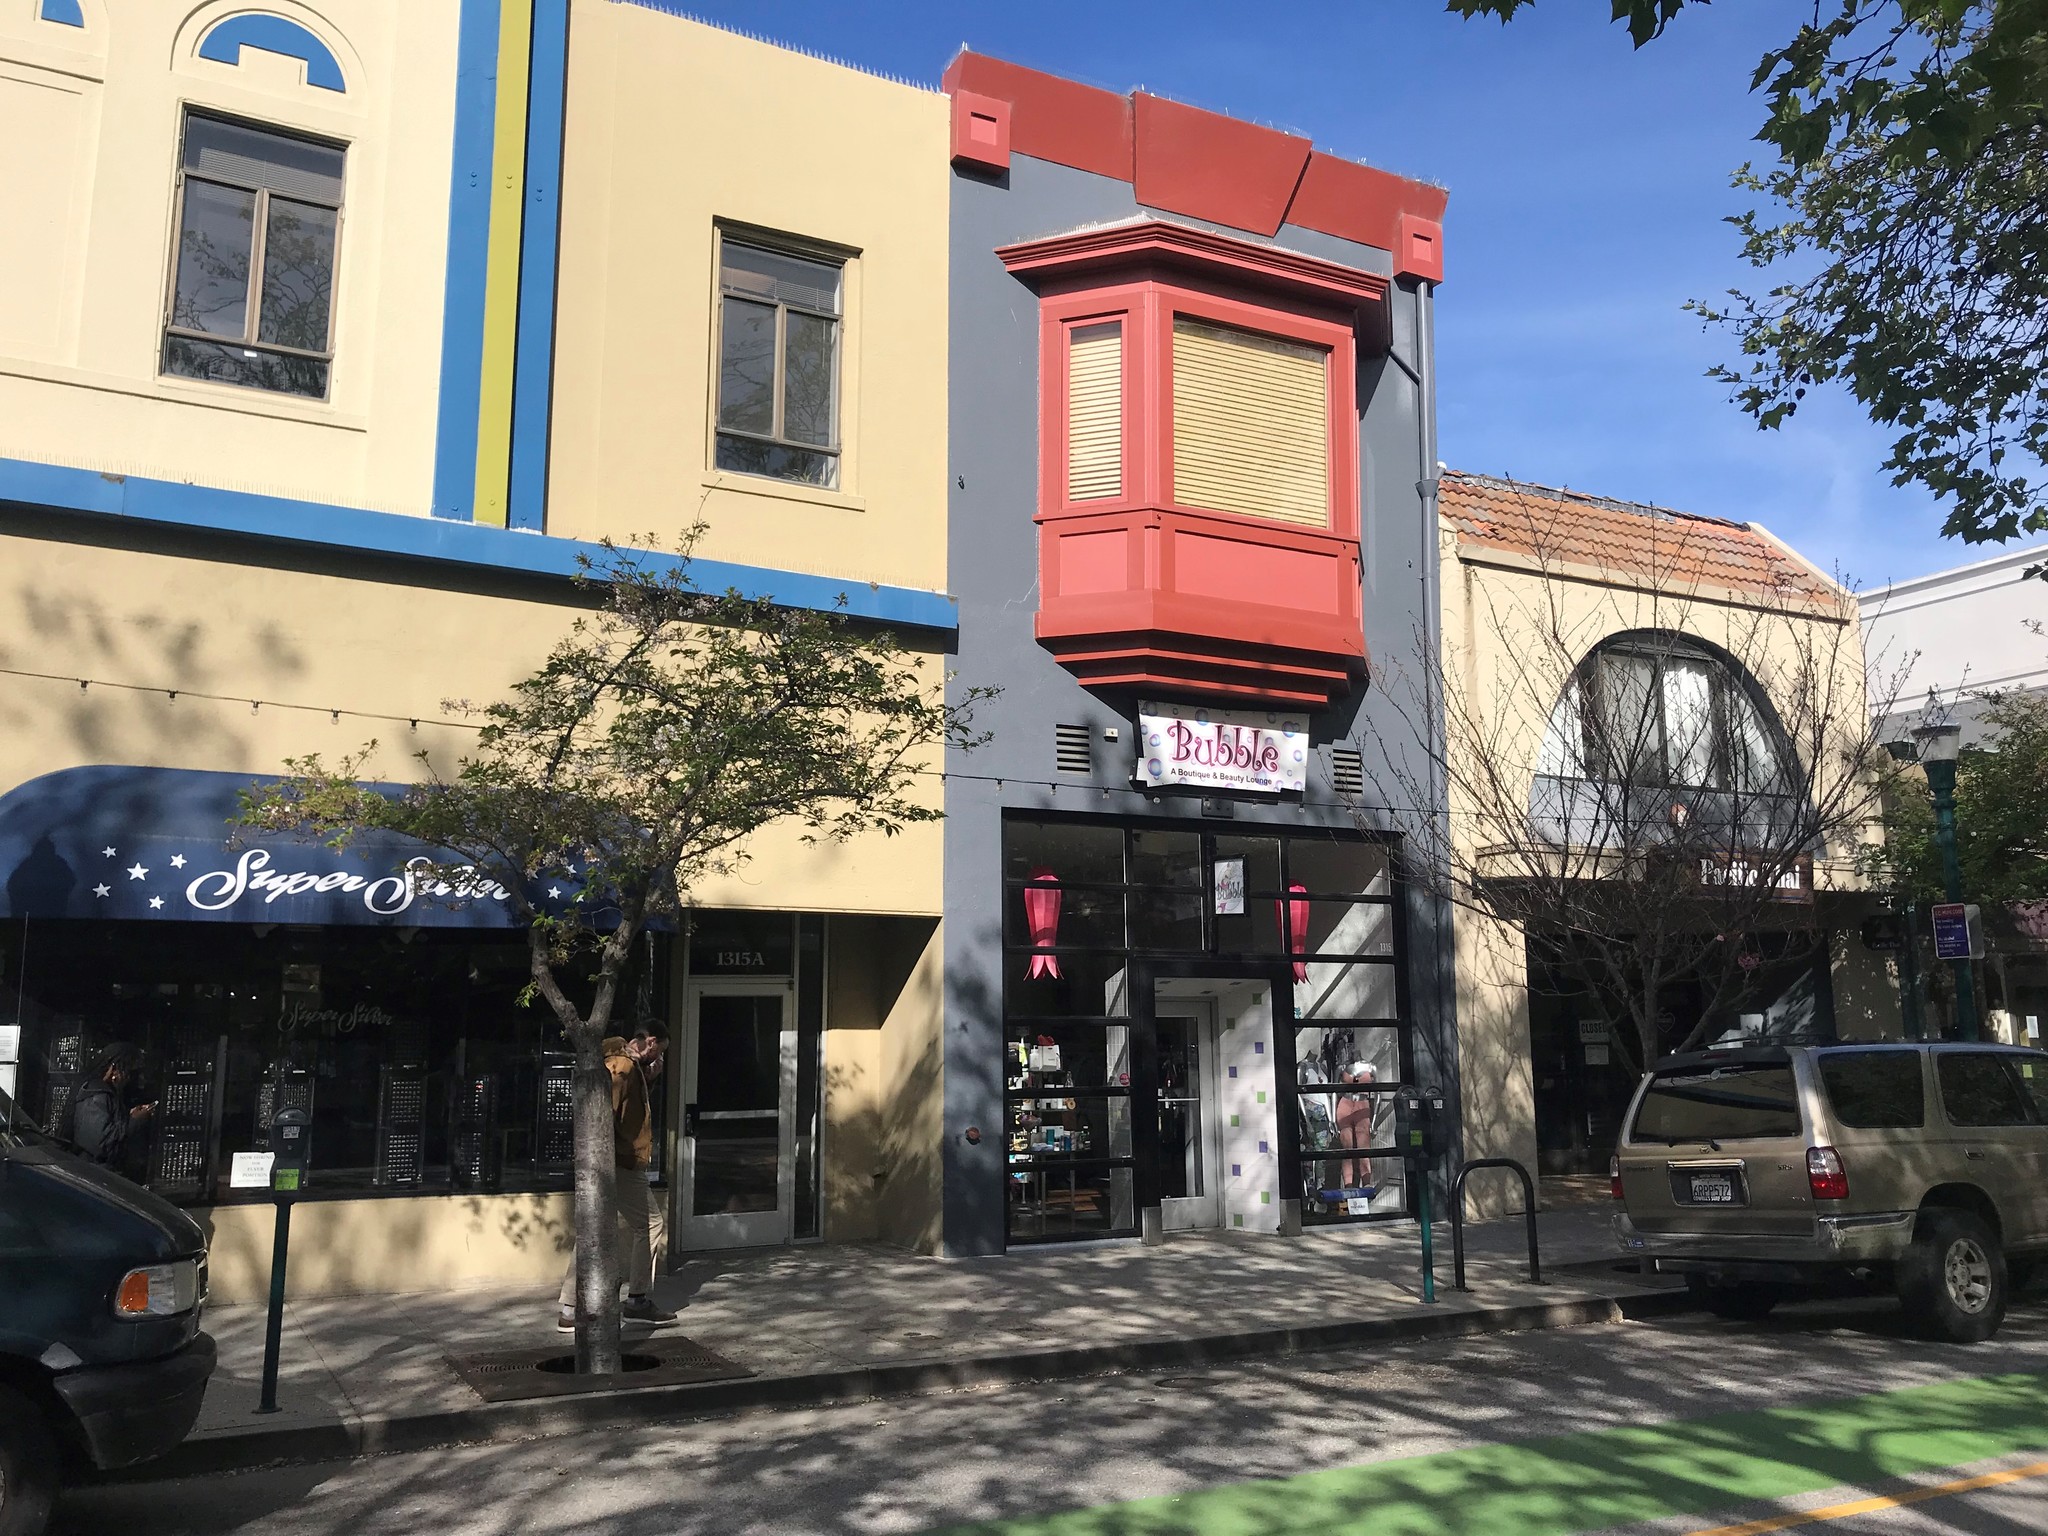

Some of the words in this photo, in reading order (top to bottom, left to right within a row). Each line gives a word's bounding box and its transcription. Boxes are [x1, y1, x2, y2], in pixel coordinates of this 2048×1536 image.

[1167, 720, 1279, 773] Bubble
[1178, 769, 1210, 779] Boutique
[1220, 773, 1245, 783] Beauty
[1246, 776, 1272, 785] Lounge
[186, 849, 368, 910] Super
[716, 952, 765, 966] 1315A
[278, 1000, 338, 1032] Super
[338, 1001, 392, 1032] Silver
[1694, 1184, 1730, 1196] 6RPP572
